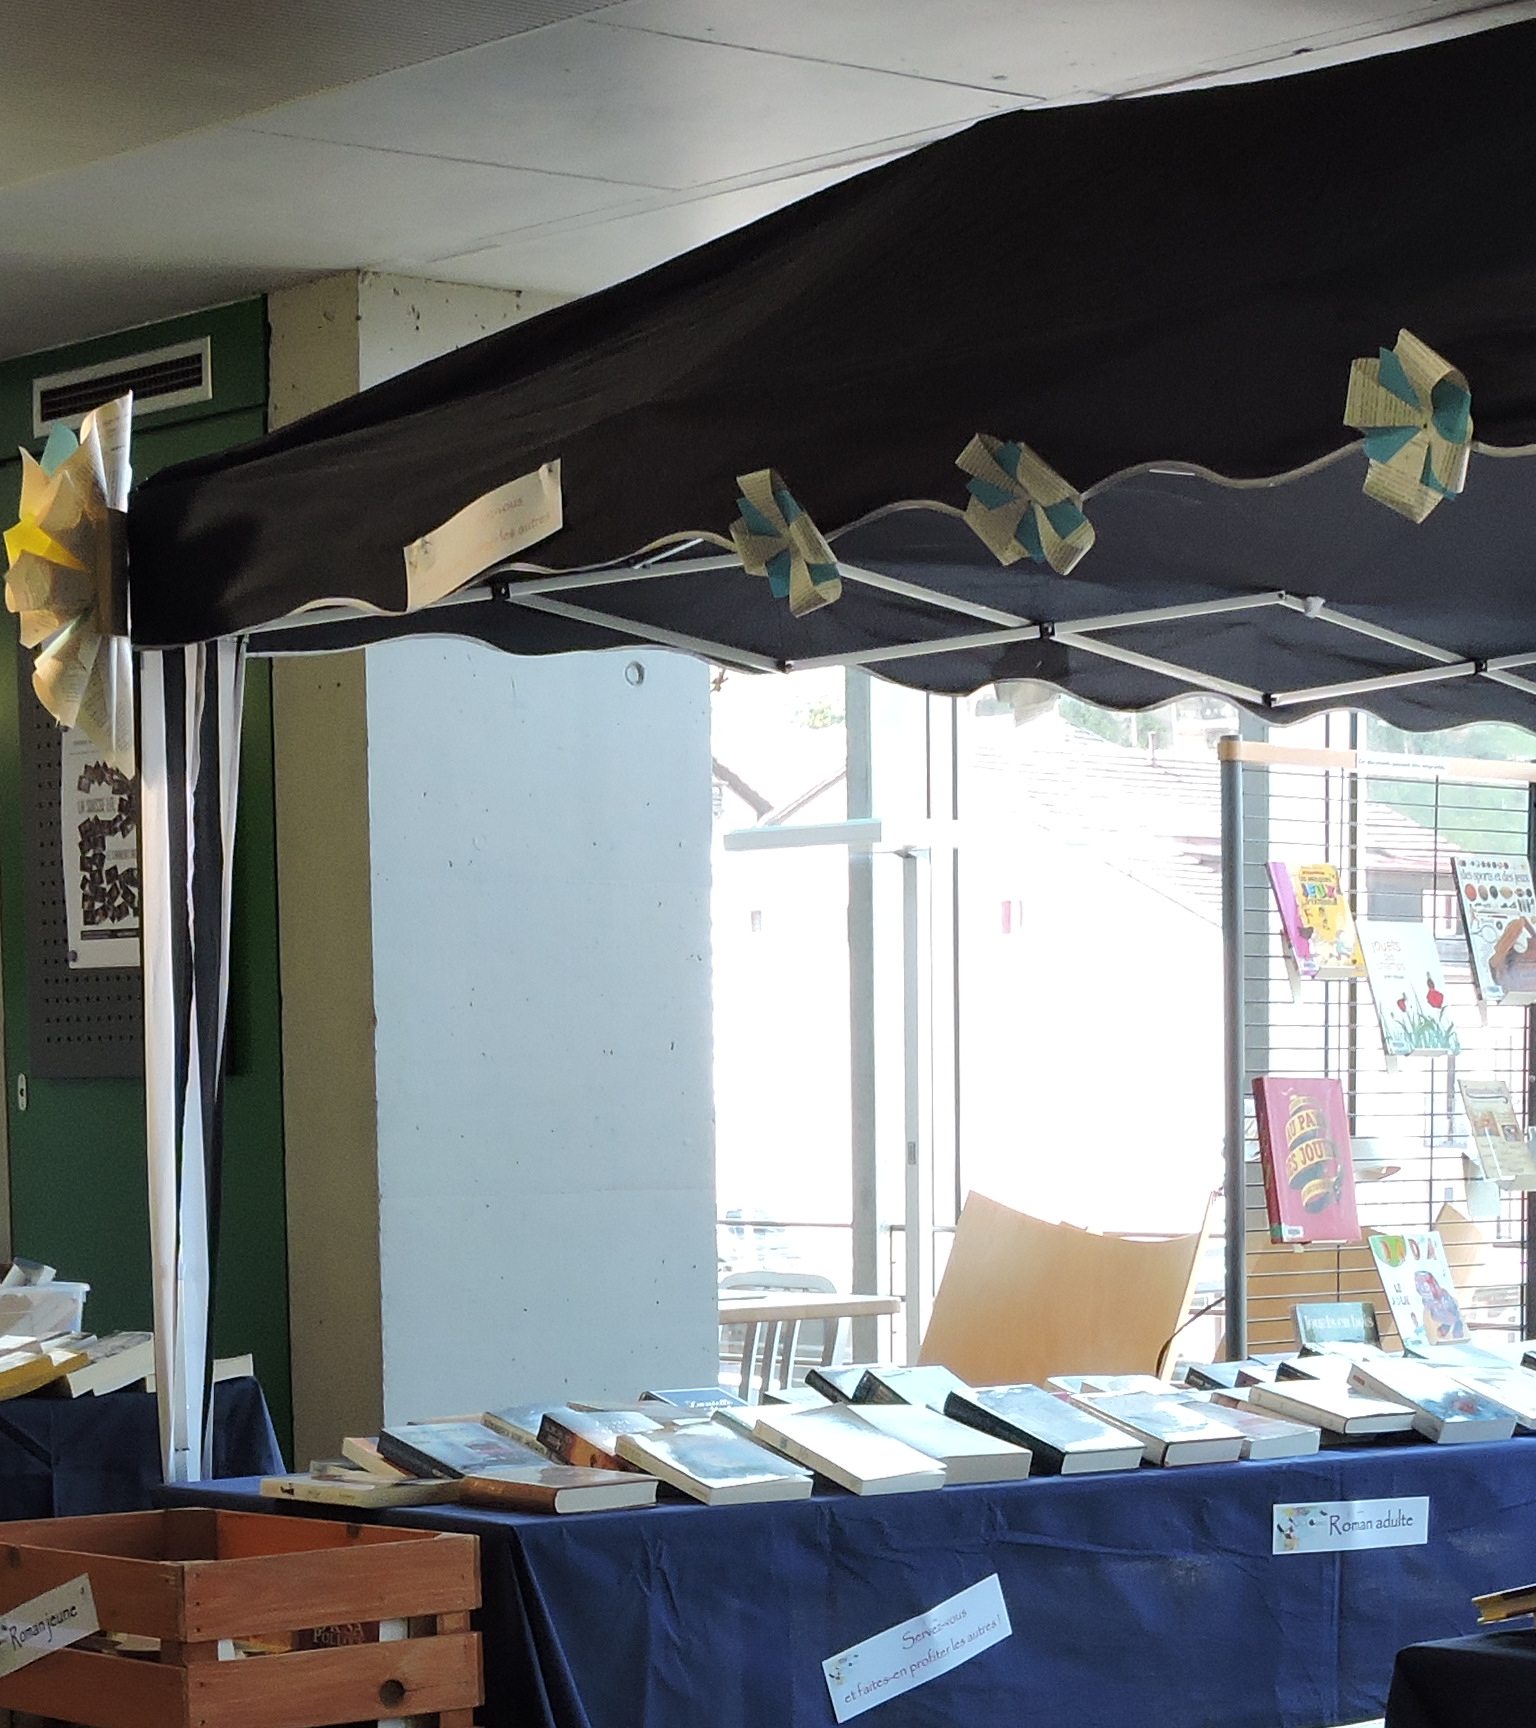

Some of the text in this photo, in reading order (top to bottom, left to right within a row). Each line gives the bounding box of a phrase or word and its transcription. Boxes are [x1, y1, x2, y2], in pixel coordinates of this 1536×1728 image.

[1329, 1508, 1414, 1536] Roman adulte
[8, 1604, 79, 1651] Roman jeune
[901, 1608, 968, 1651] Servez-vous
[844, 1689, 857, 1704] et
[857, 1668, 908, 1697] faites-en
[909, 1648, 951, 1678] profiter
[951, 1637, 965, 1653] les
[966, 1621, 997, 1644] autres
